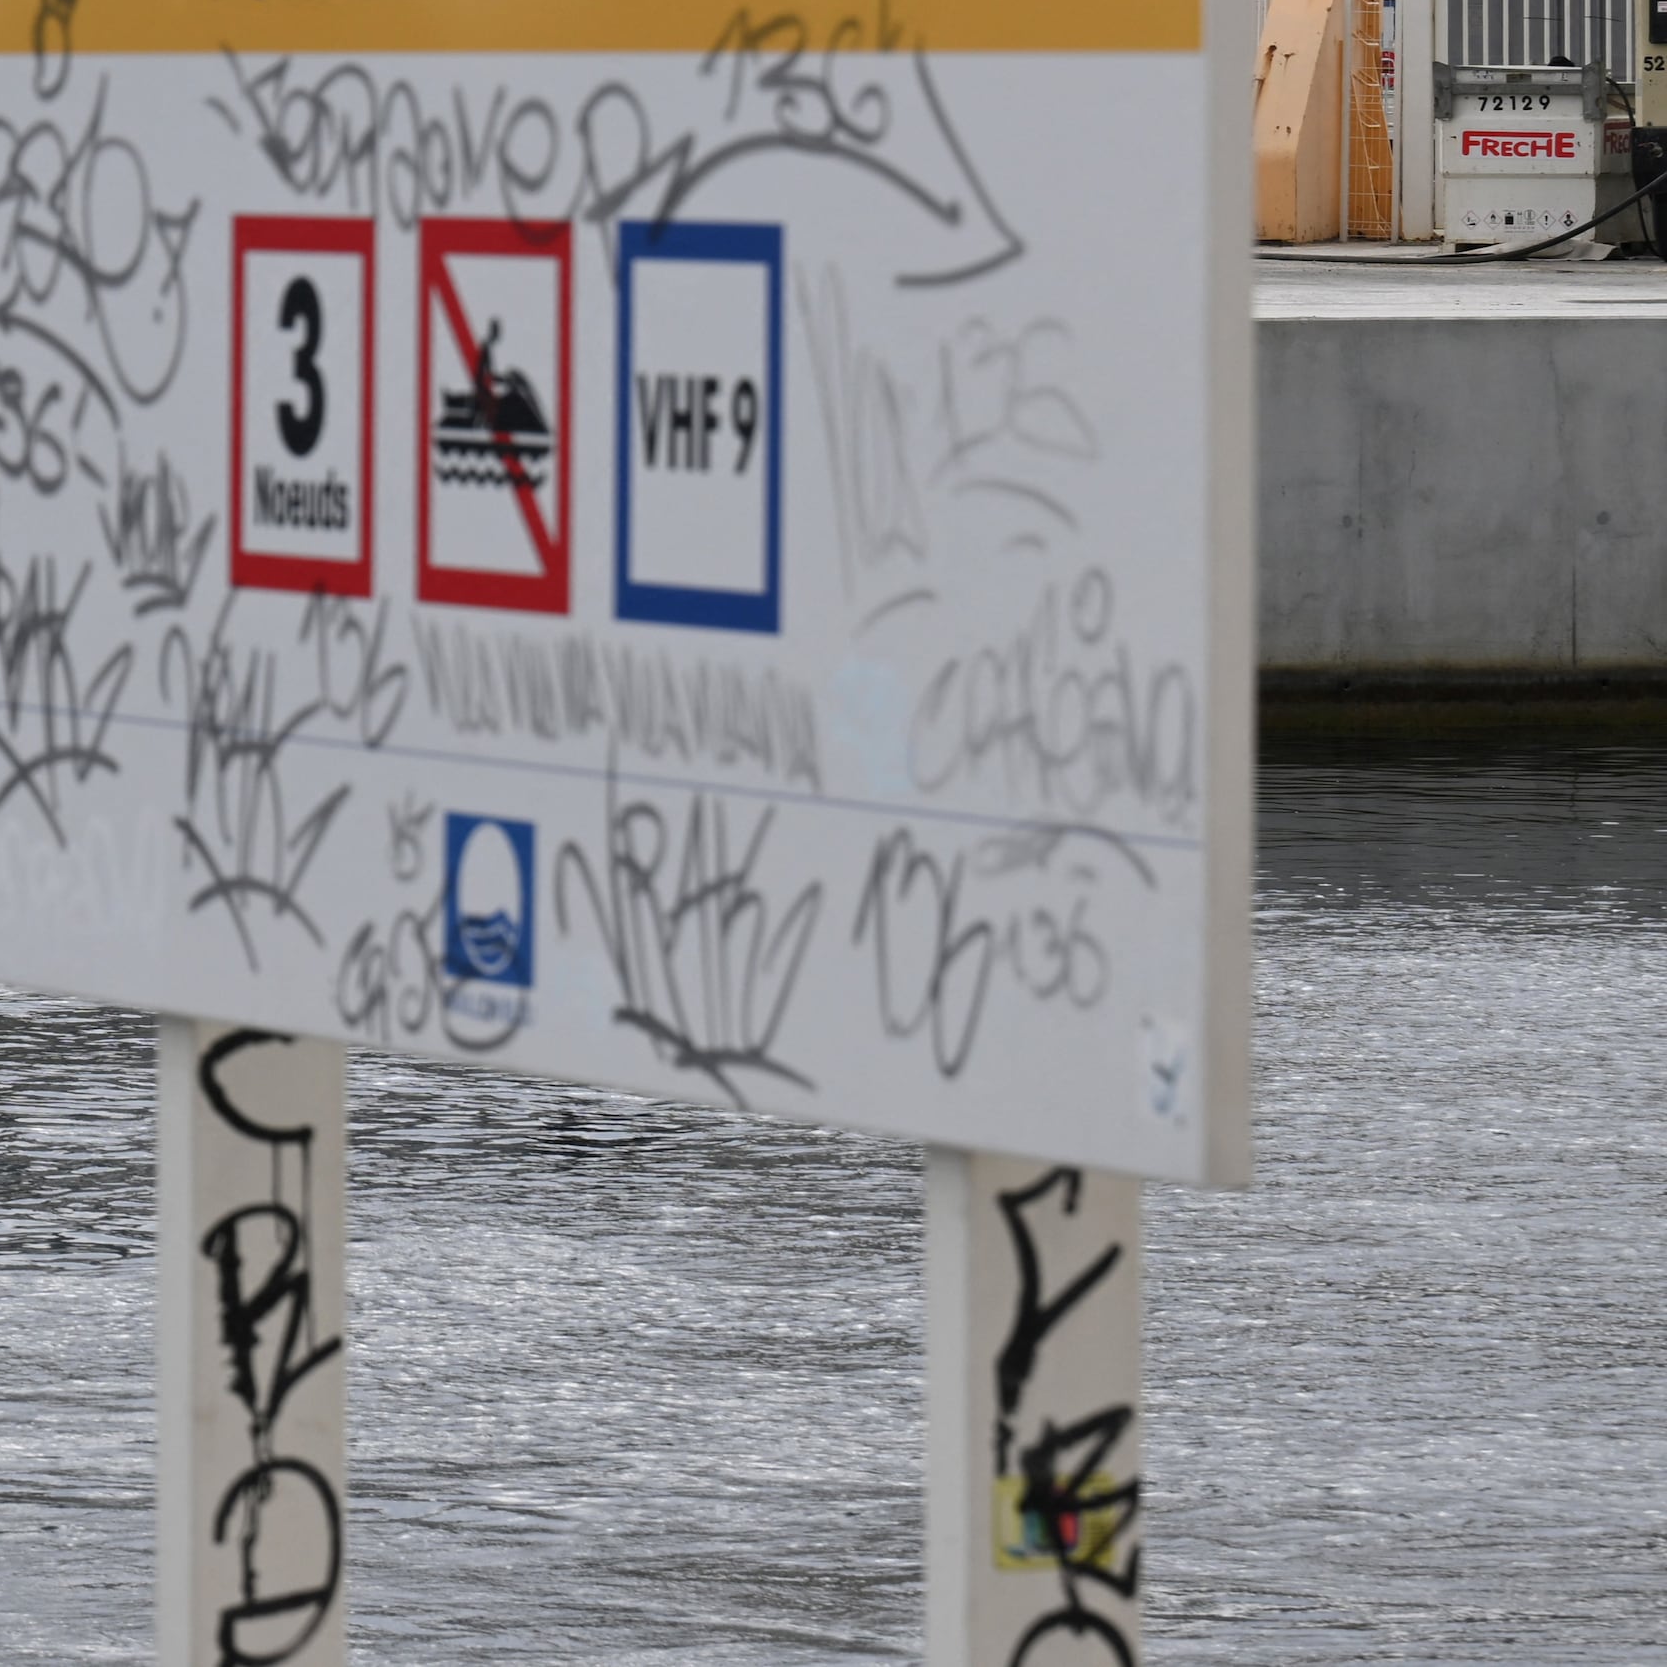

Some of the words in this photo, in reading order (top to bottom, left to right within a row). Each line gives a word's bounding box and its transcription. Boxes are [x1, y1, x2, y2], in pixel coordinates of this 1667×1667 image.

[1644, 56, 1665, 71] 52
[1478, 95, 1551, 112] 72129
[1462, 131, 1575, 158] FRECHE
[1603, 122, 1632, 154] FREC
[274, 276, 329, 459] 3
[637, 372, 722, 473] VHF
[730, 375, 760, 475] 9
[254, 465, 351, 533] Noeuds
